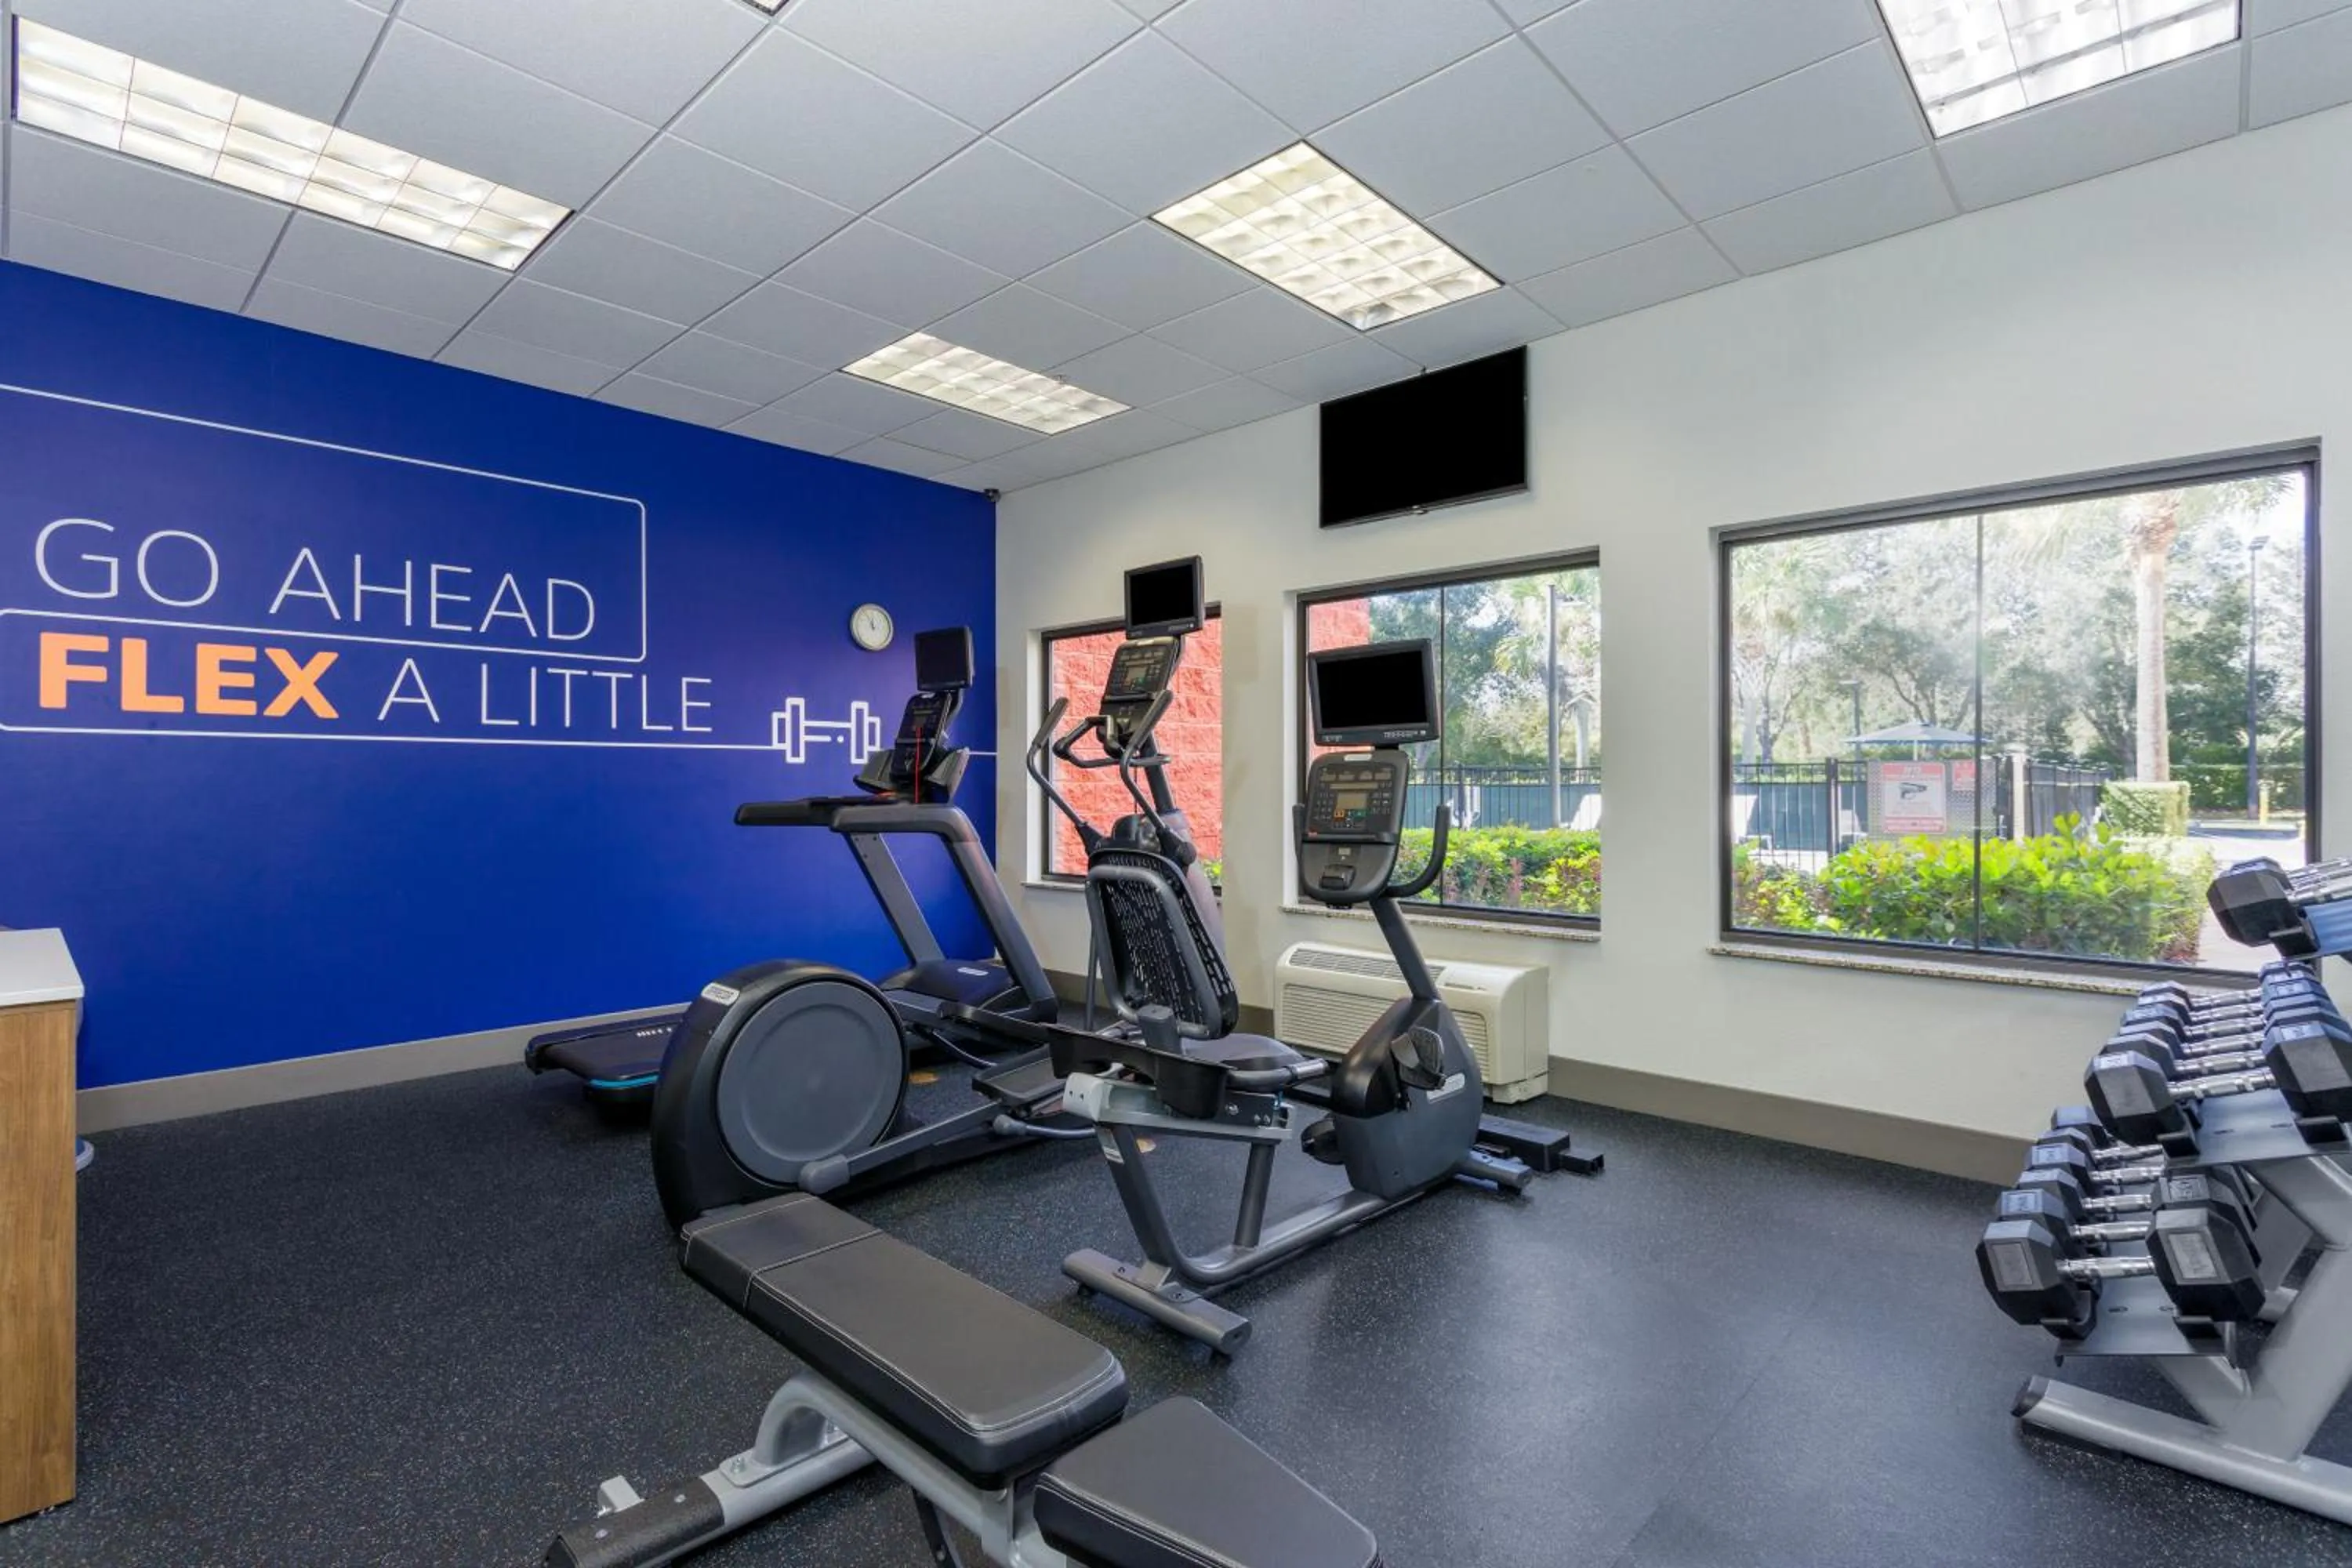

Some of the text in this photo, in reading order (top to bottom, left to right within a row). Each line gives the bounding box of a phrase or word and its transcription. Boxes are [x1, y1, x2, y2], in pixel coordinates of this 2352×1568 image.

[34, 518, 596, 641] GO AHEAD
[38, 632, 713, 732] FLEX A LITTLE
